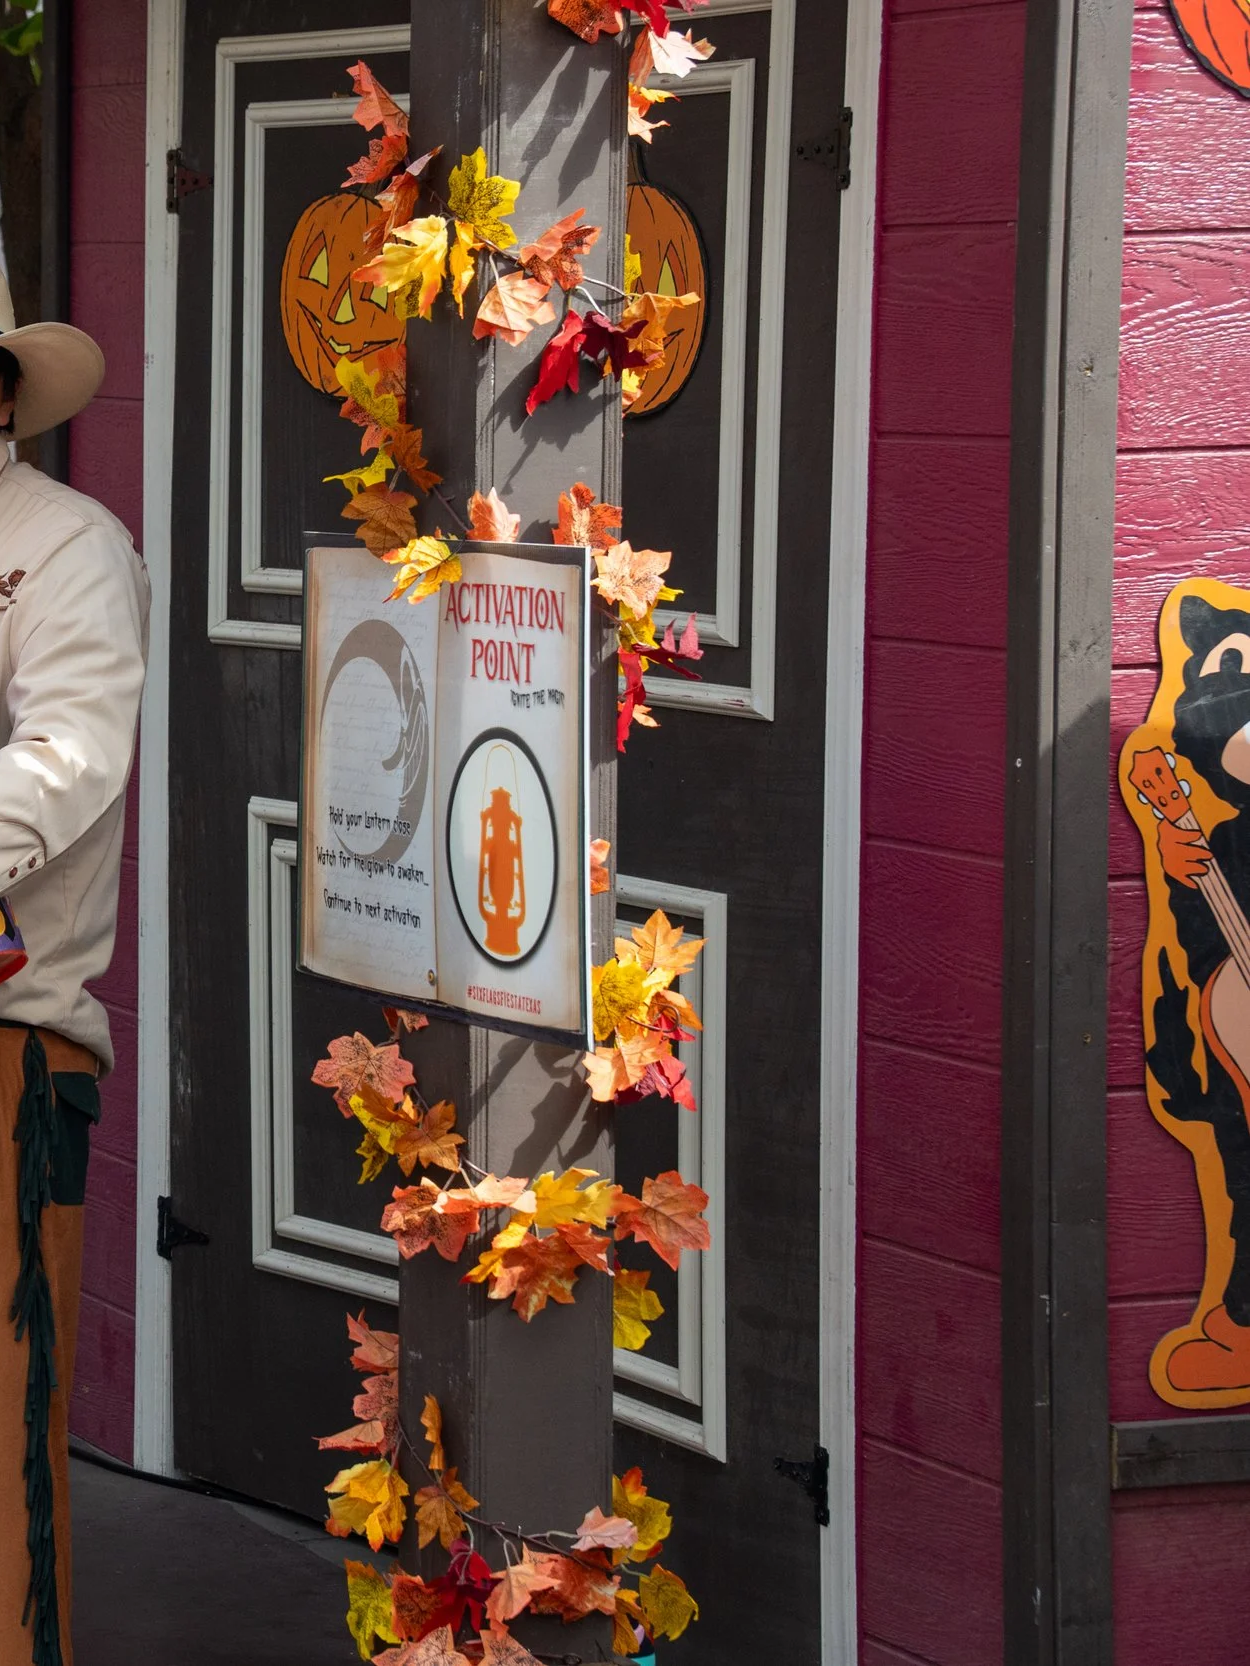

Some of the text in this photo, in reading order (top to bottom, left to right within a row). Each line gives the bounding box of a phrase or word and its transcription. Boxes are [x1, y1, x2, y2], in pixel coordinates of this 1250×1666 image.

[444, 582, 565, 636] ACTIVATION
[470, 638, 536, 686] POINT
[533, 690, 546, 706] THE
[329, 805, 344, 826] Hold
[346, 812, 363, 831] your
[393, 816, 411, 835] close
[316, 846, 337, 866] Watch
[354, 853, 365, 872] the
[367, 857, 384, 878] glow
[386, 859, 395, 877] to
[323, 888, 421, 929] Continue to next activation
[467, 985, 541, 1015] #SIXFLAGSFIESTATEXAS
